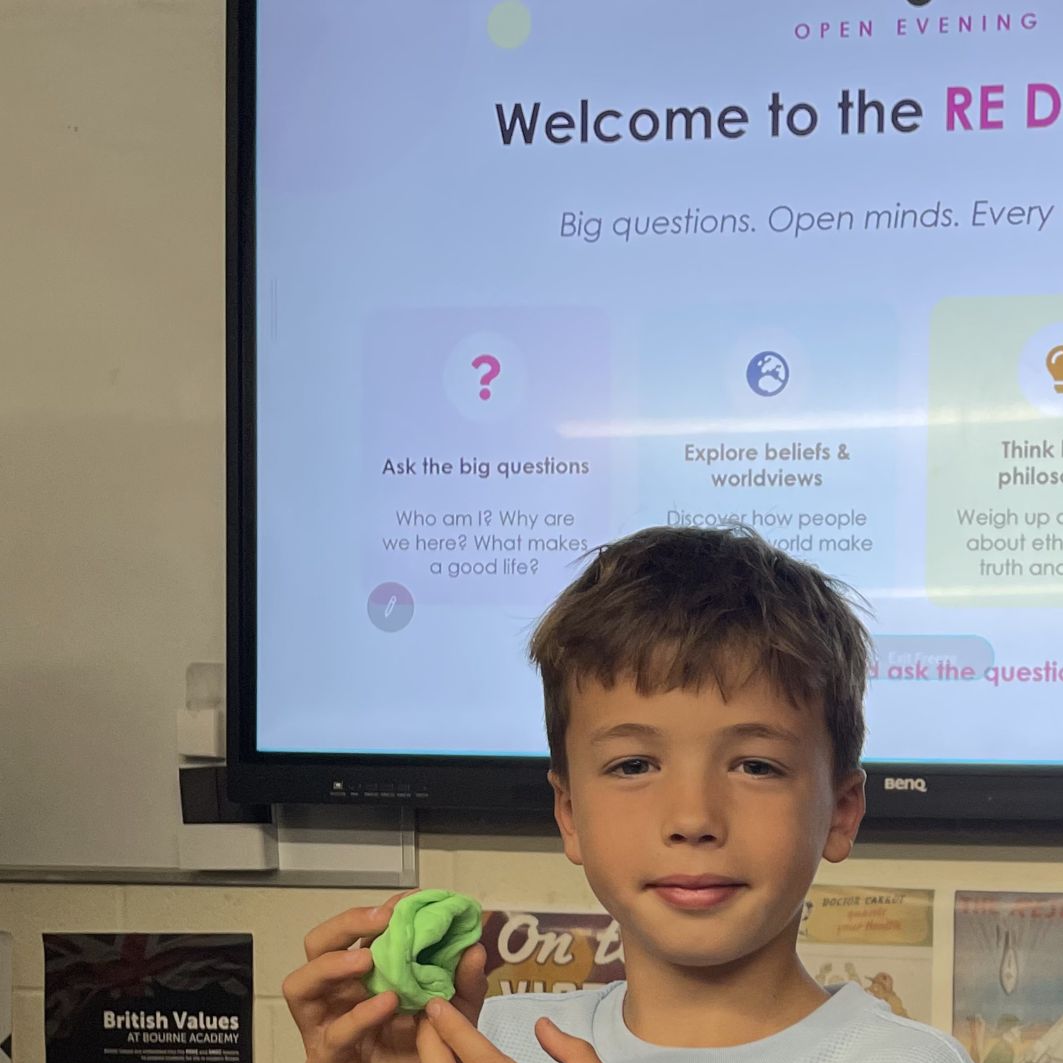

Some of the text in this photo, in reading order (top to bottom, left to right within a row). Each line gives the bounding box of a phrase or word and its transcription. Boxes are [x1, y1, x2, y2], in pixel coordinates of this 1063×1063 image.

[794, 11, 1040, 41] OPEN EVENING
[494, 99, 750, 146] Welcome
[766, 91, 819, 138] to
[837, 88, 925, 135] the
[944, 84, 1006, 132] RE
[559, 211, 602, 243] Big
[612, 207, 757, 239] questions.
[767, 205, 854, 237] Open
[863, 202, 961, 231] minds.
[970, 199, 1053, 235] Every
[684, 442, 852, 466] Explore beliefs &
[1001, 439, 1055, 460] Think
[382, 457, 590, 483] Ask the big questions
[710, 467, 824, 489] worldviews
[396, 509, 575, 530] Who am I? Why are
[667, 509, 868, 530] Discover how people
[956, 507, 1018, 533] Weigh
[1024, 512, 1051, 532] up
[382, 533, 588, 552] we here? What makes
[819, 535, 873, 552] make
[965, 533, 1026, 553] about
[430, 557, 539, 580] a good life?
[979, 557, 1024, 577] truth
[887, 660, 929, 680] ask
[936, 659, 977, 681] the
[884, 777, 928, 793] BenQ
[497, 912, 574, 965] On
[103, 1010, 240, 1031] British Values
[127, 1032, 240, 1045] AT BOURNE ACADEMY
